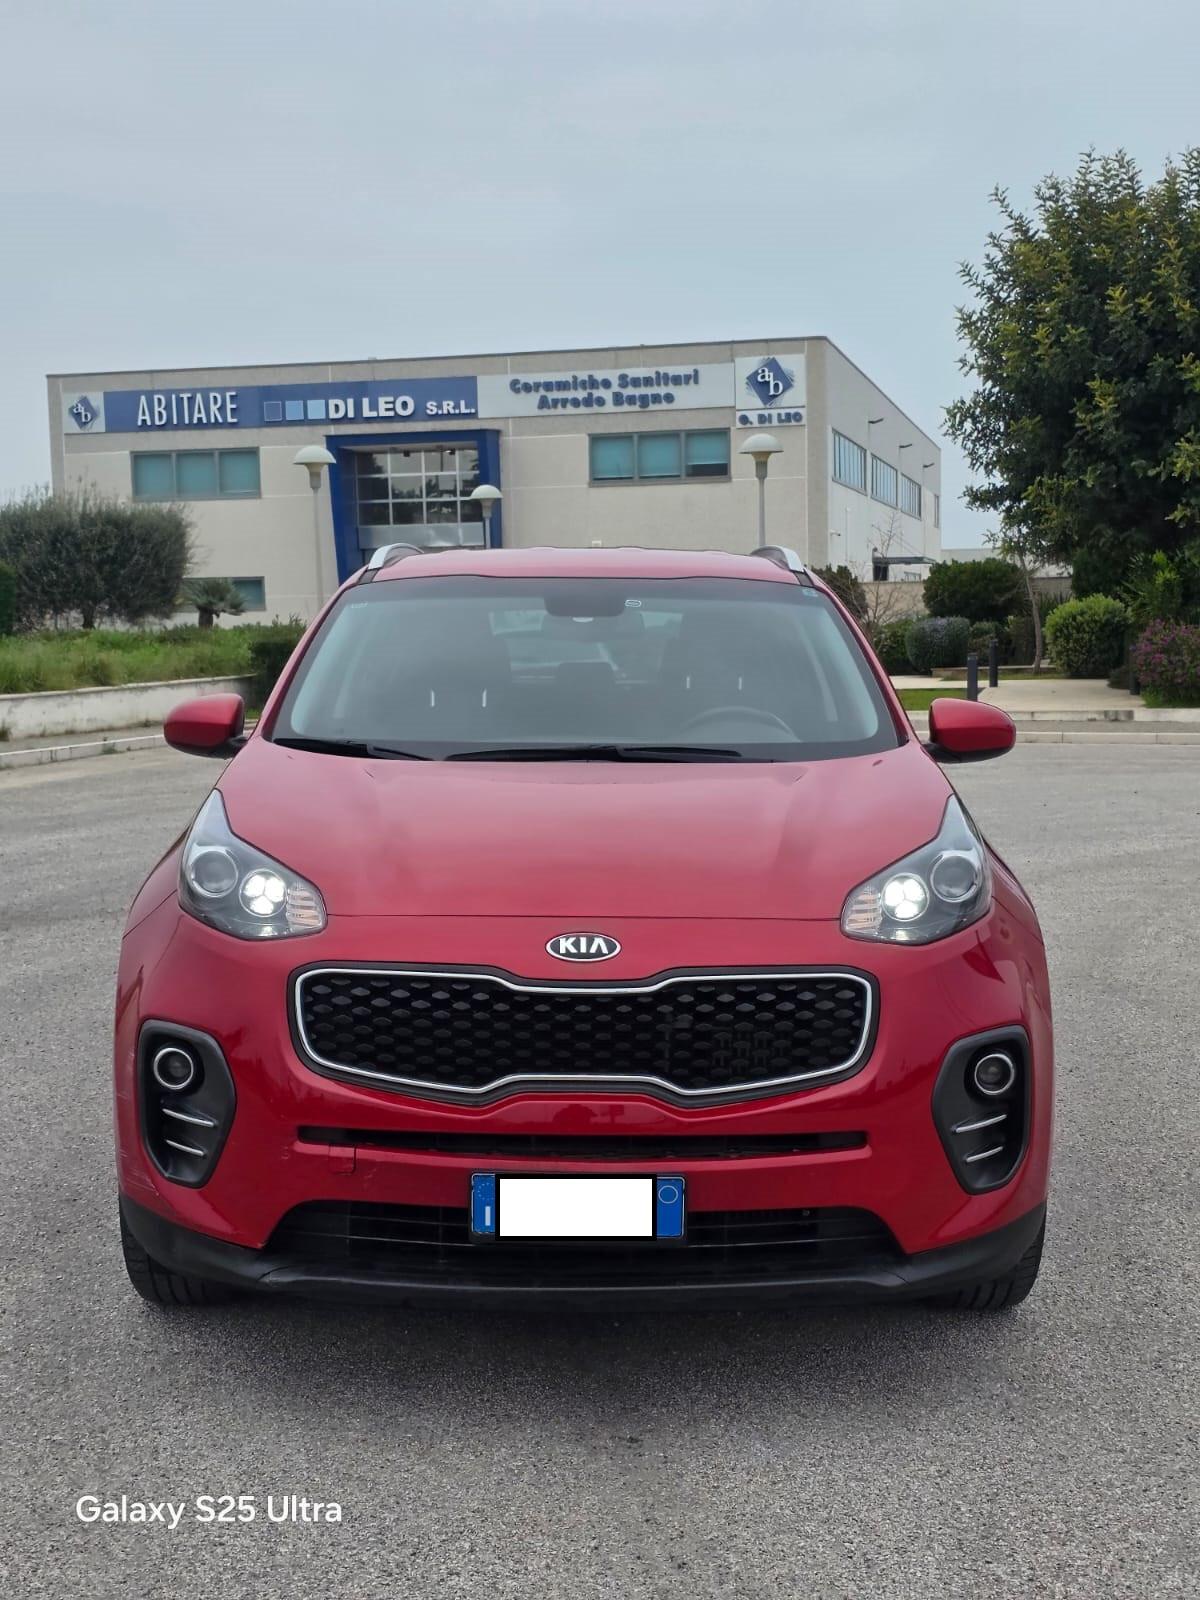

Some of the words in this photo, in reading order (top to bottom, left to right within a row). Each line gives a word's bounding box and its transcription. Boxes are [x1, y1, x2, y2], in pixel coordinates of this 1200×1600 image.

[617, 368, 700, 389] Sanitari
[137, 391, 239, 426] ABITARE
[328, 398, 355, 419] DI
[362, 396, 415, 417] LEO
[426, 400, 476, 416] S.R.L.
[537, 391, 606, 410] Arredo
[612, 391, 675, 409] Bagno
[757, 413, 773, 425] DI
[777, 411, 803, 424] LEO
[559, 936, 609, 954] KIA
